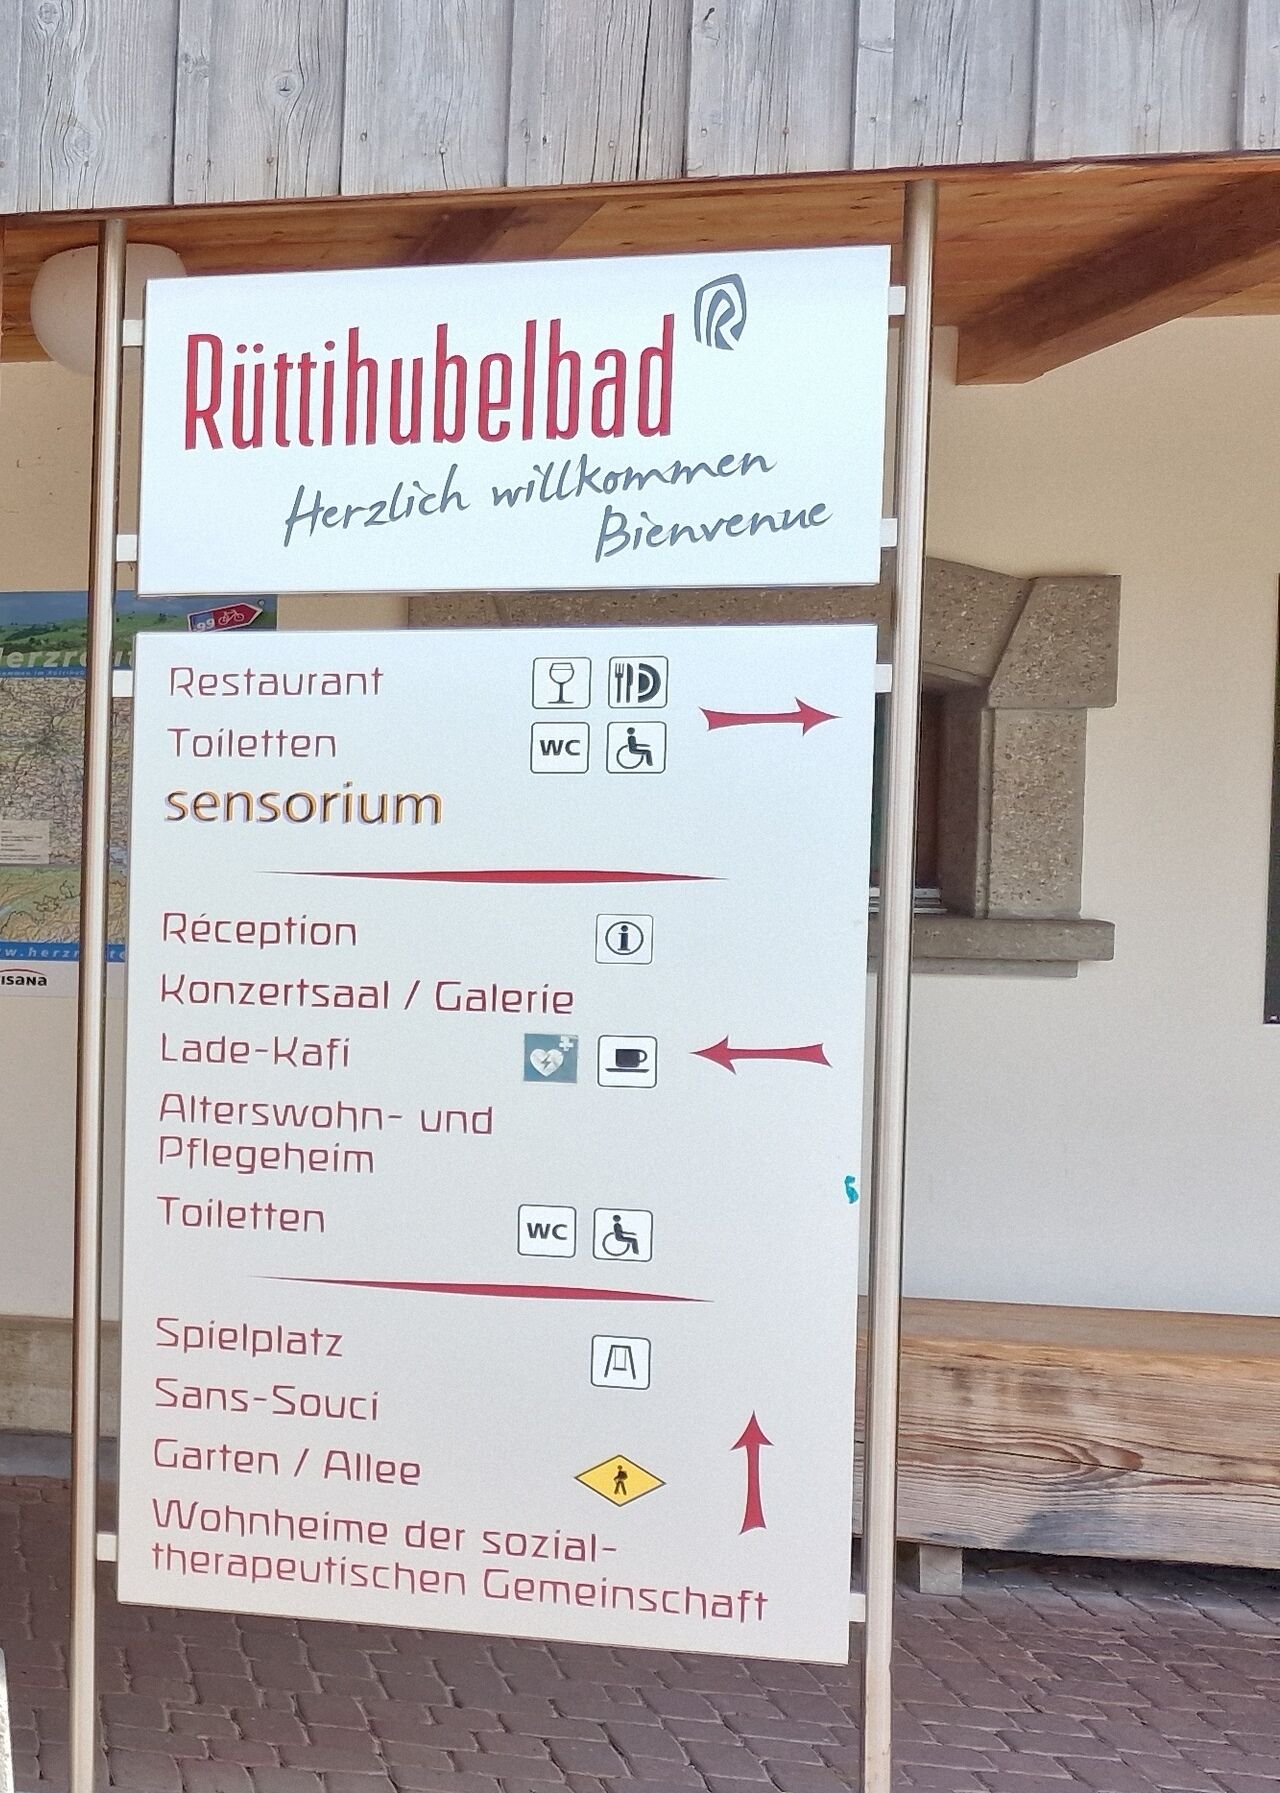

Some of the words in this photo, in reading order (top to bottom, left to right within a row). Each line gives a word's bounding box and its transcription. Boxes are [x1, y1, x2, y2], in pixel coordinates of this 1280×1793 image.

[184, 313, 675, 451] Rüttihubelbad
[283, 463, 471, 548] Herzlich
[491, 452, 776, 510] willkommen
[594, 502, 833, 563] Bienvenue
[170, 666, 384, 699] Restaurant
[167, 728, 336, 758] Toiletten
[539, 739, 581, 757] WC
[166, 781, 442, 825] sensorium
[163, 912, 357, 950] Réception
[161, 973, 389, 1010] Konzertsaal
[403, 979, 421, 1011] /
[435, 981, 574, 1015] Galerie
[161, 1032, 350, 1071] Lade-Kafi
[159, 1093, 403, 1133] Alterswohn-
[420, 1106, 493, 1135] und
[159, 1135, 374, 1175] Pflegeheim
[157, 1196, 325, 1233] Toiletten
[526, 1222, 568, 1241] WC
[156, 1317, 343, 1358] Spielplatz
[155, 1377, 379, 1421] Sans-Souci
[154, 1438, 279, 1476] Garten
[293, 1447, 310, 1478] /
[323, 1449, 421, 1486] Allee
[151, 1498, 388, 1546] Wohnheime
[405, 1519, 466, 1552] der
[482, 1529, 617, 1563] sozial-
[151, 1541, 466, 1596] therapeutischen
[483, 1568, 769, 1623] Gemeinschaft
